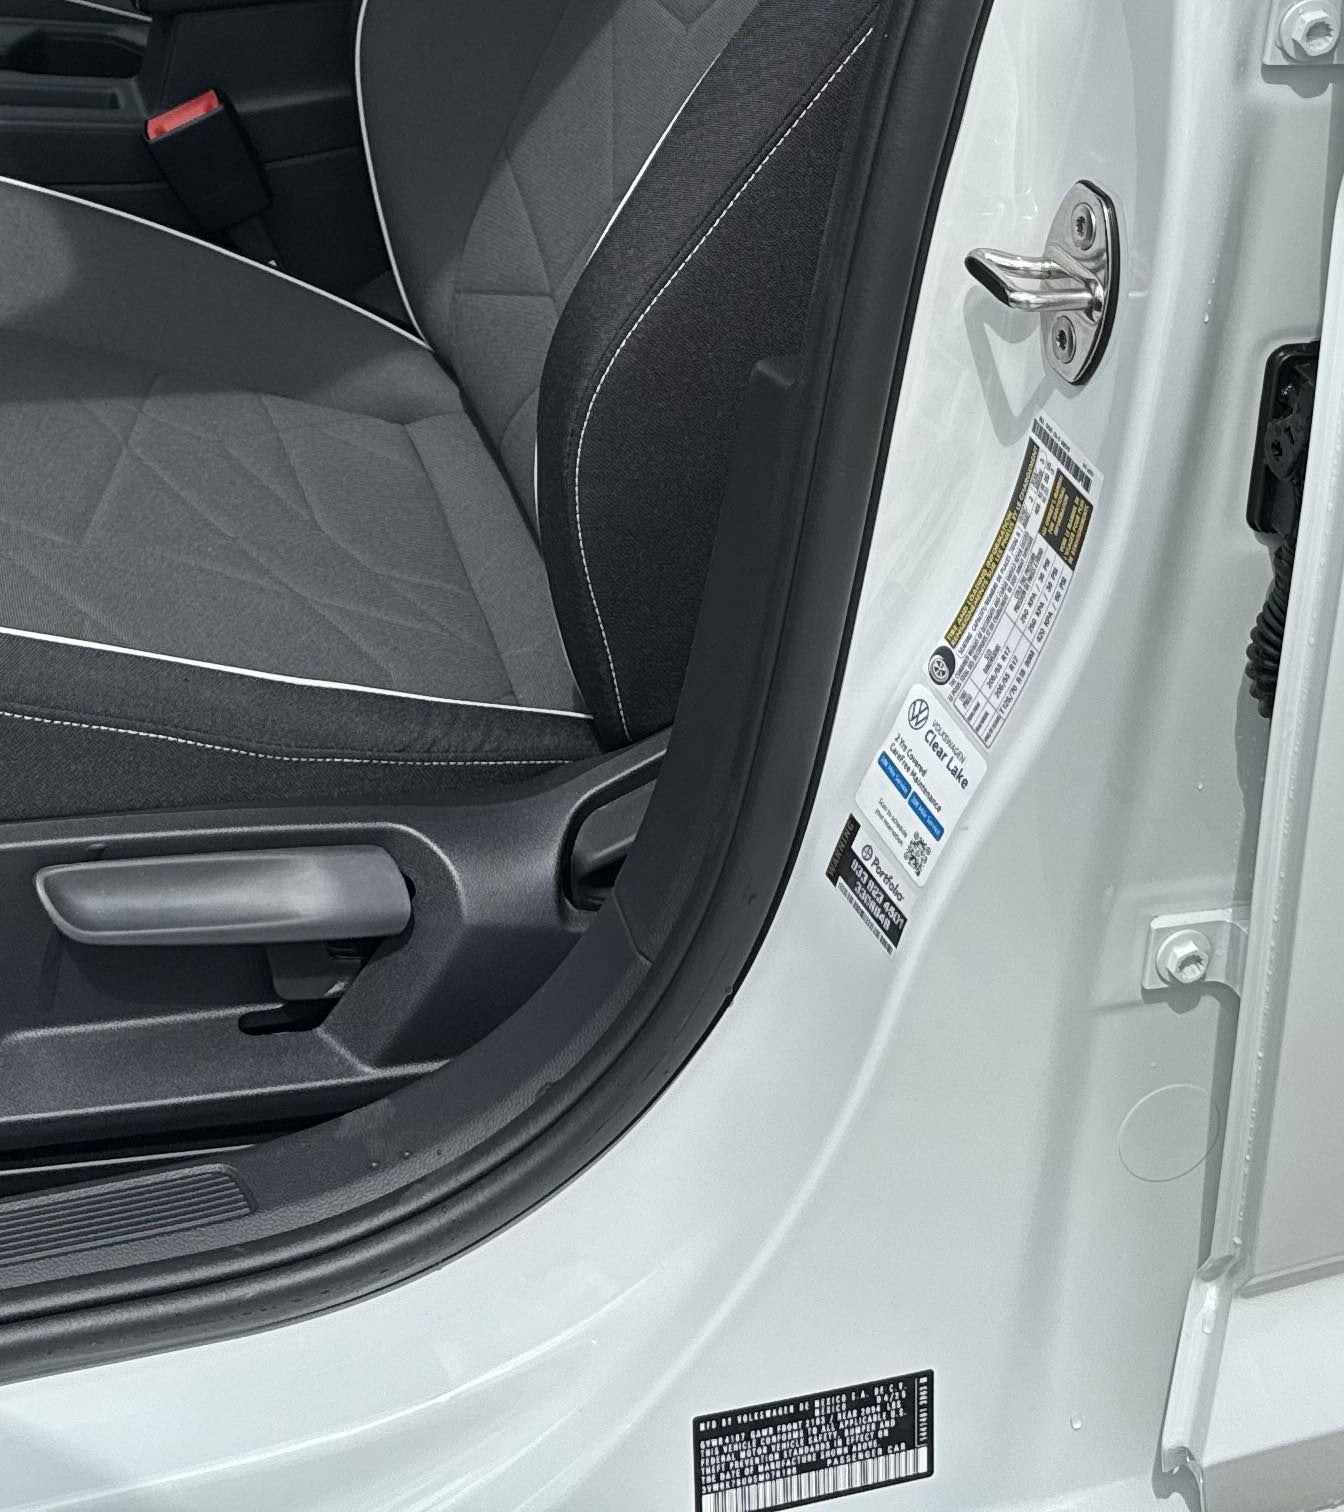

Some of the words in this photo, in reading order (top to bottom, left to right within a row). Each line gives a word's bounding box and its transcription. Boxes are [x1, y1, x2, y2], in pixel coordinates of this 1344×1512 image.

[933, 719, 965, 764] VOLKSWAGEN
[907, 749, 927, 777] Covered
[925, 730, 948, 762] Clear
[946, 756, 968, 789] Lake
[911, 769, 941, 813] Maintenance
[828, 821, 854, 877] WARNING
[737, 1404, 794, 1424] VOLKSWAGEN
[723, 1438, 756, 1453] VEHICLE
[760, 1430, 803, 1446] CONFORMS
[839, 1411, 886, 1429] APPLICABLE
[701, 1453, 735, 1467] FEDERAL
[740, 1446, 767, 1459] MOTOR
[720, 1469, 740, 1481] DATE
[757, 1452, 817, 1473] MANUFACTURE
[729, 1452, 779, 1469] PREVENTION
[783, 1441, 830, 1459] STANDARDS
[827, 1448, 882, 1467] PASSENGER
[887, 1442, 905, 1454] CAR
